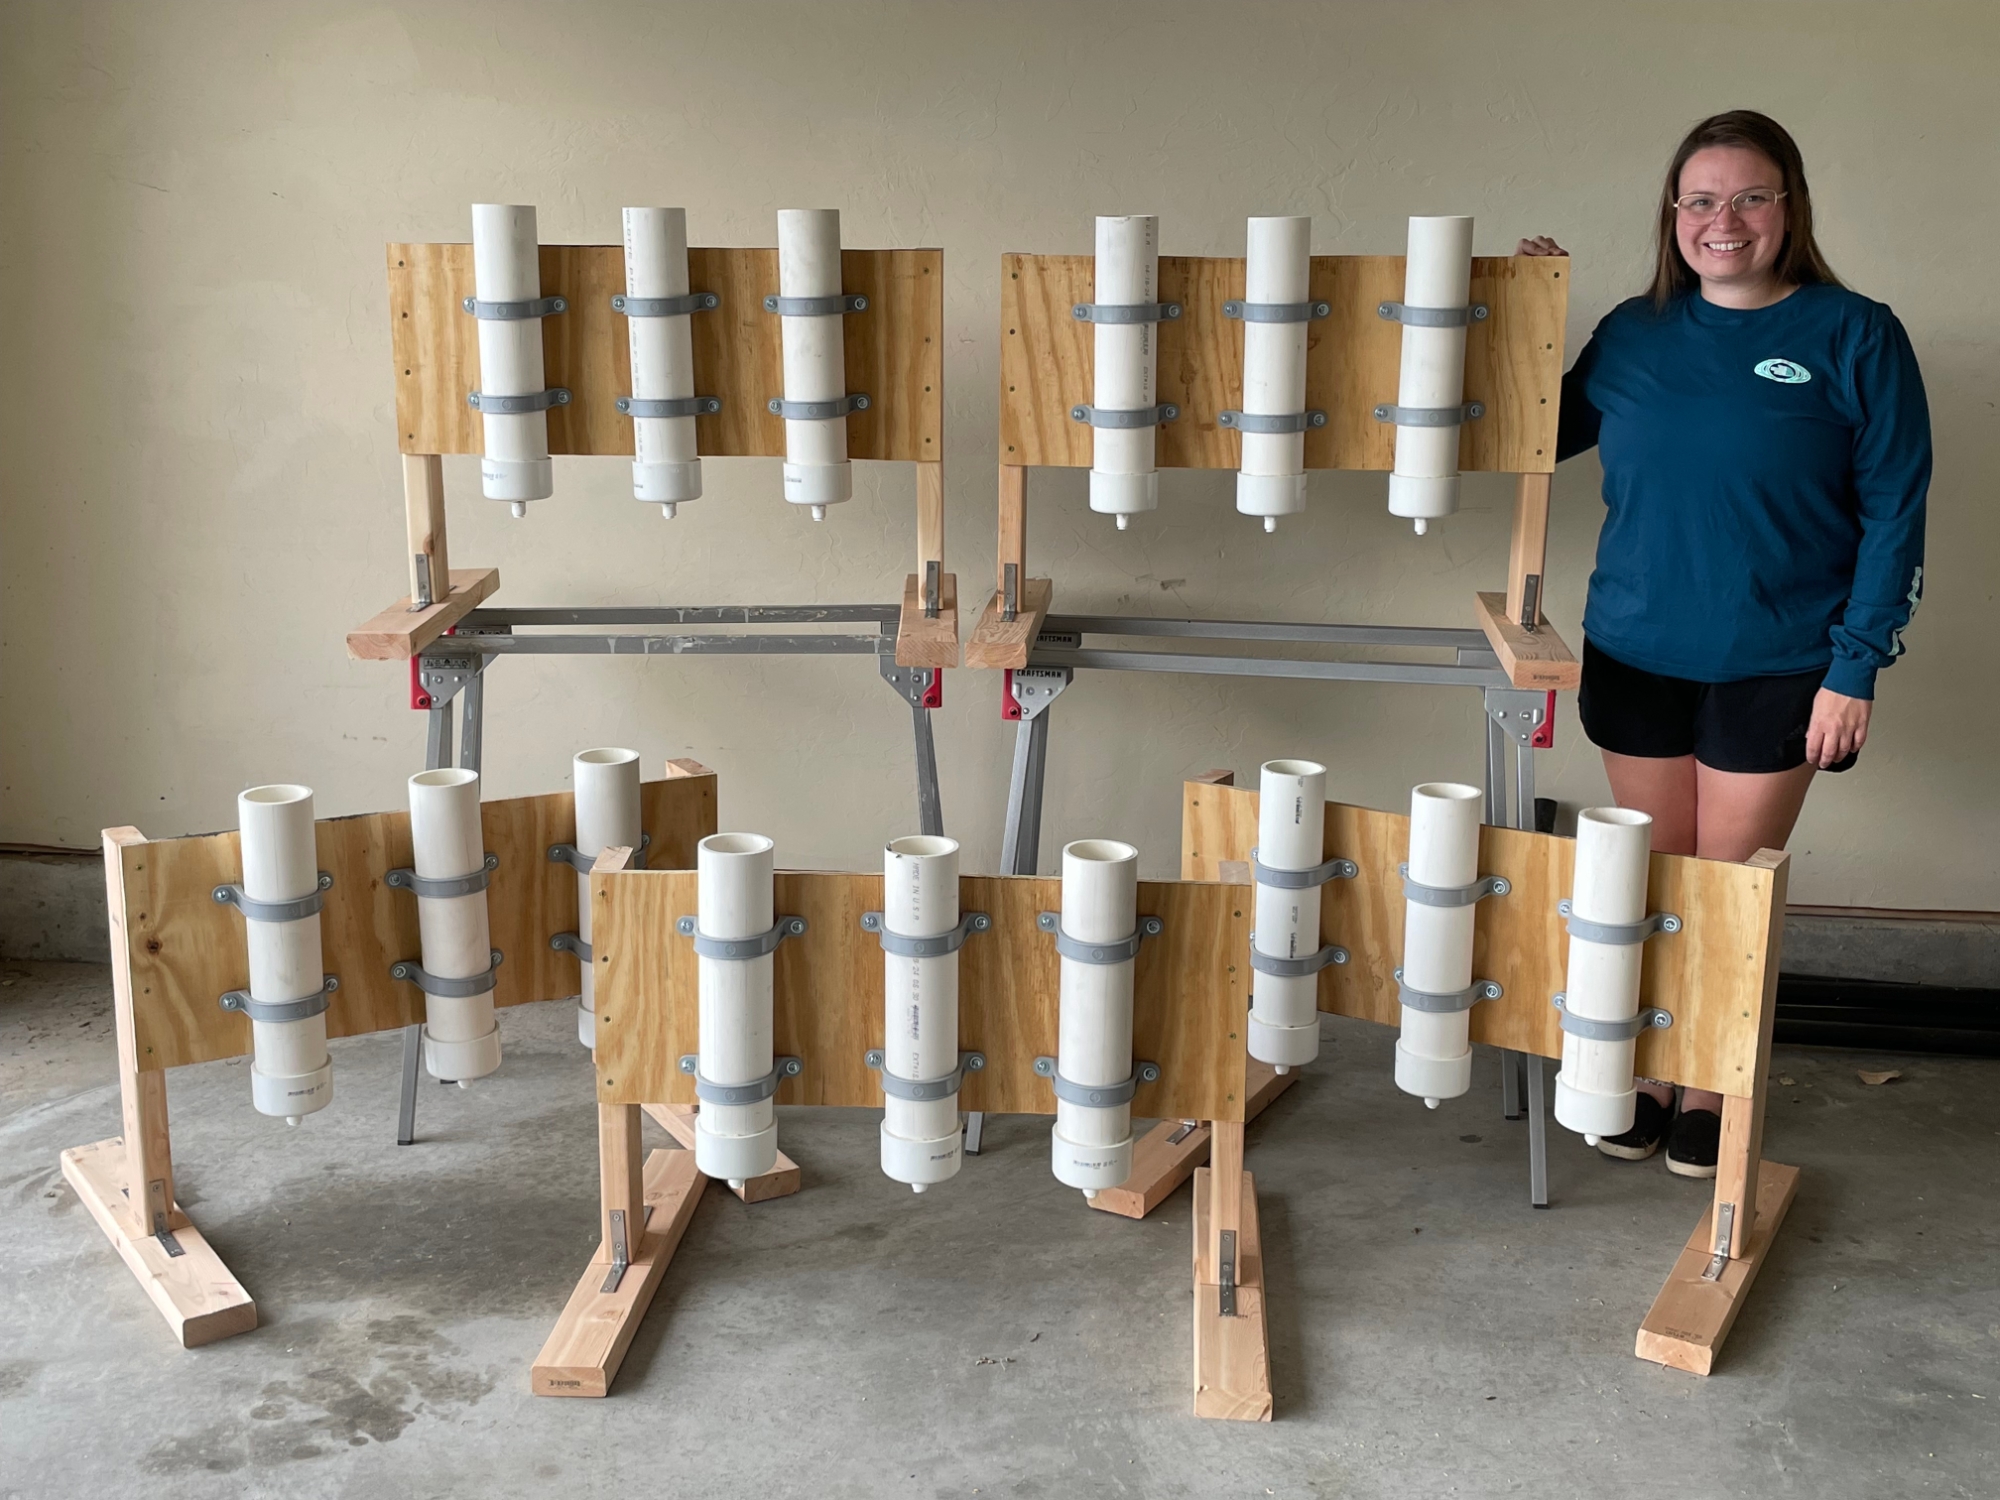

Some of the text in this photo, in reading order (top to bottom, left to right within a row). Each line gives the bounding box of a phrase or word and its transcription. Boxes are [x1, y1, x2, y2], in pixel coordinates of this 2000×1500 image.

[1016, 669, 1062, 679] CRAFTSMAN
[912, 862, 920, 881] MADE
[912, 885, 920, 895] IN
